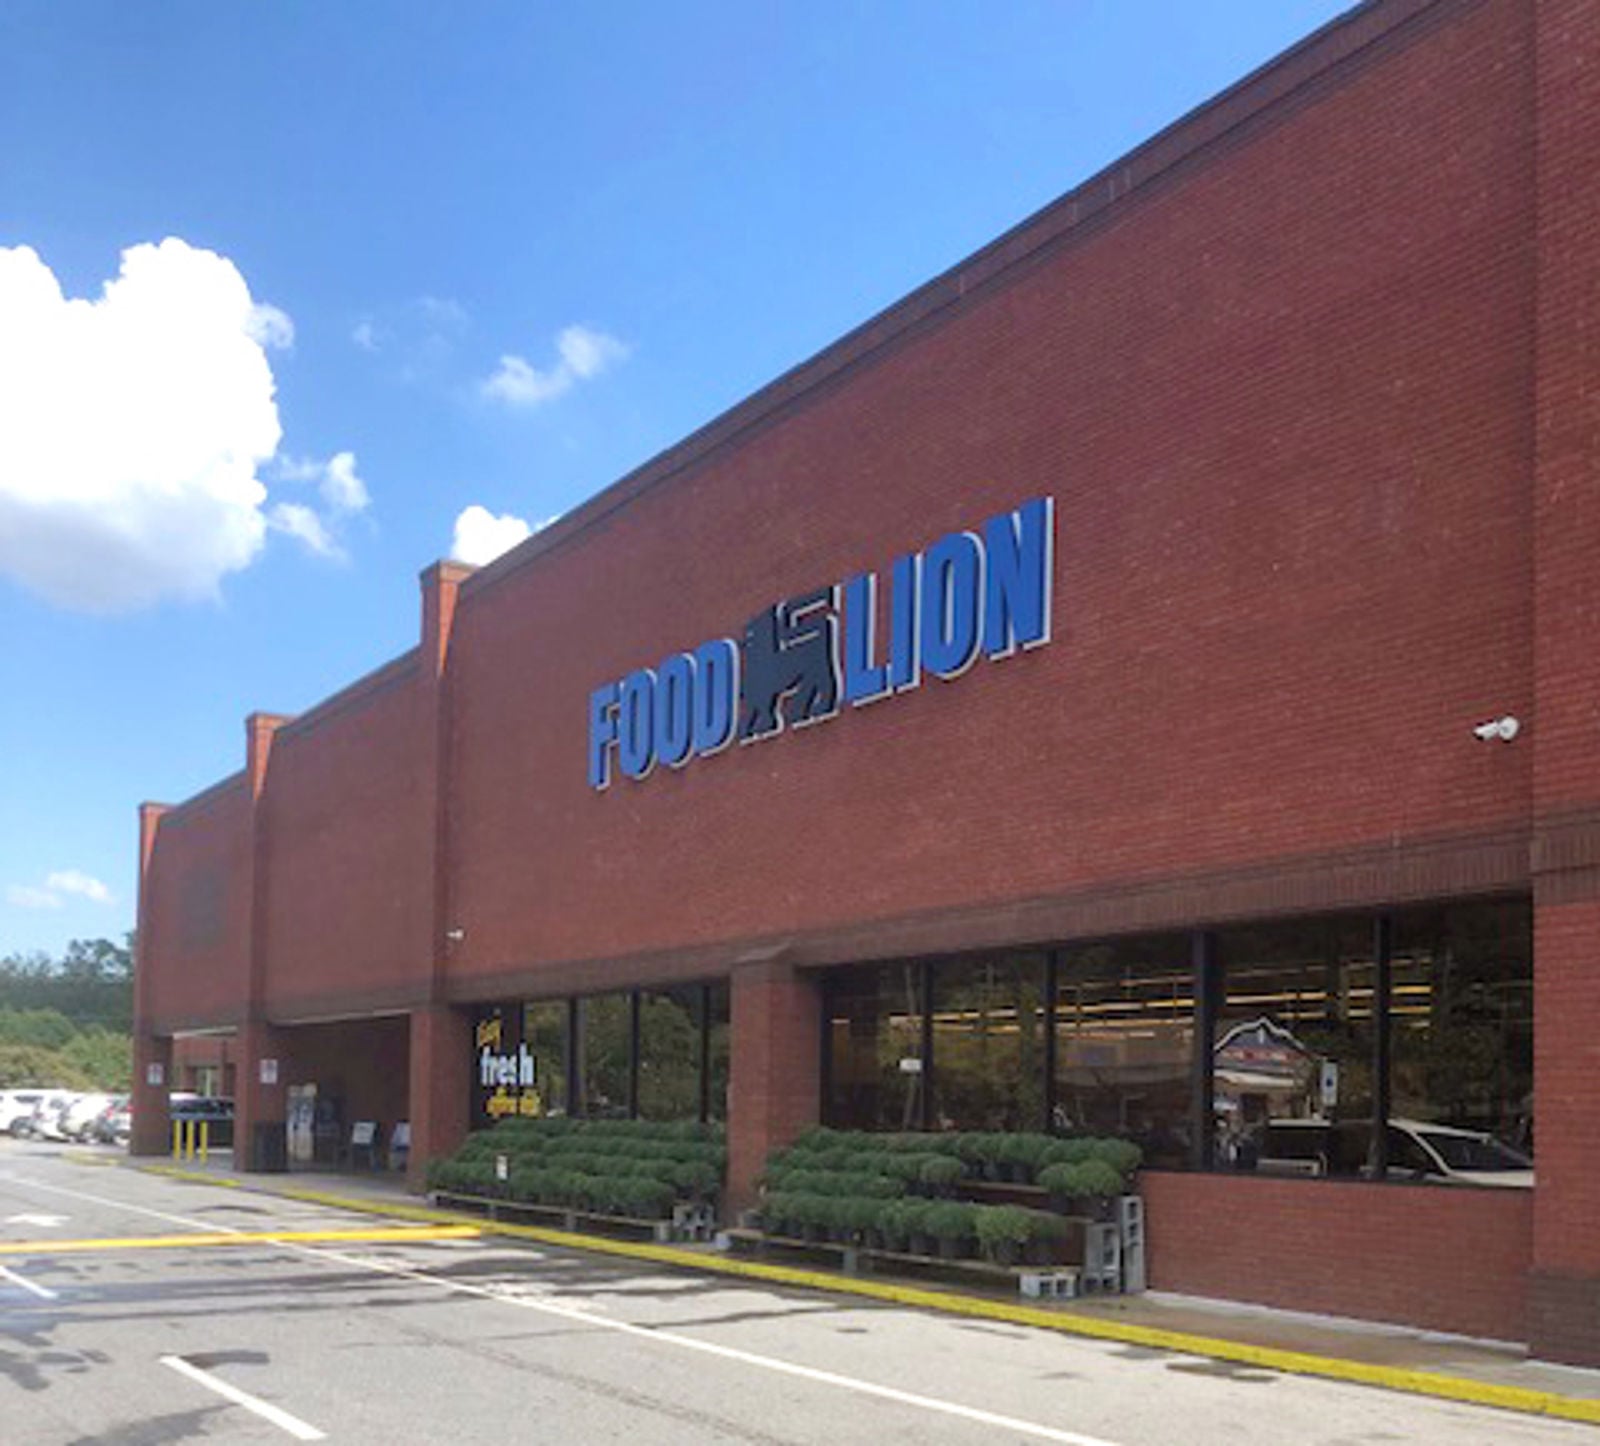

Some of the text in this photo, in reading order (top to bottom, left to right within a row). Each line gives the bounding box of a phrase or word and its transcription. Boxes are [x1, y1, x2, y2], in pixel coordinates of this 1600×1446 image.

[588, 496, 1054, 790] FOOD LION
[480, 1043, 534, 1086] fresh
